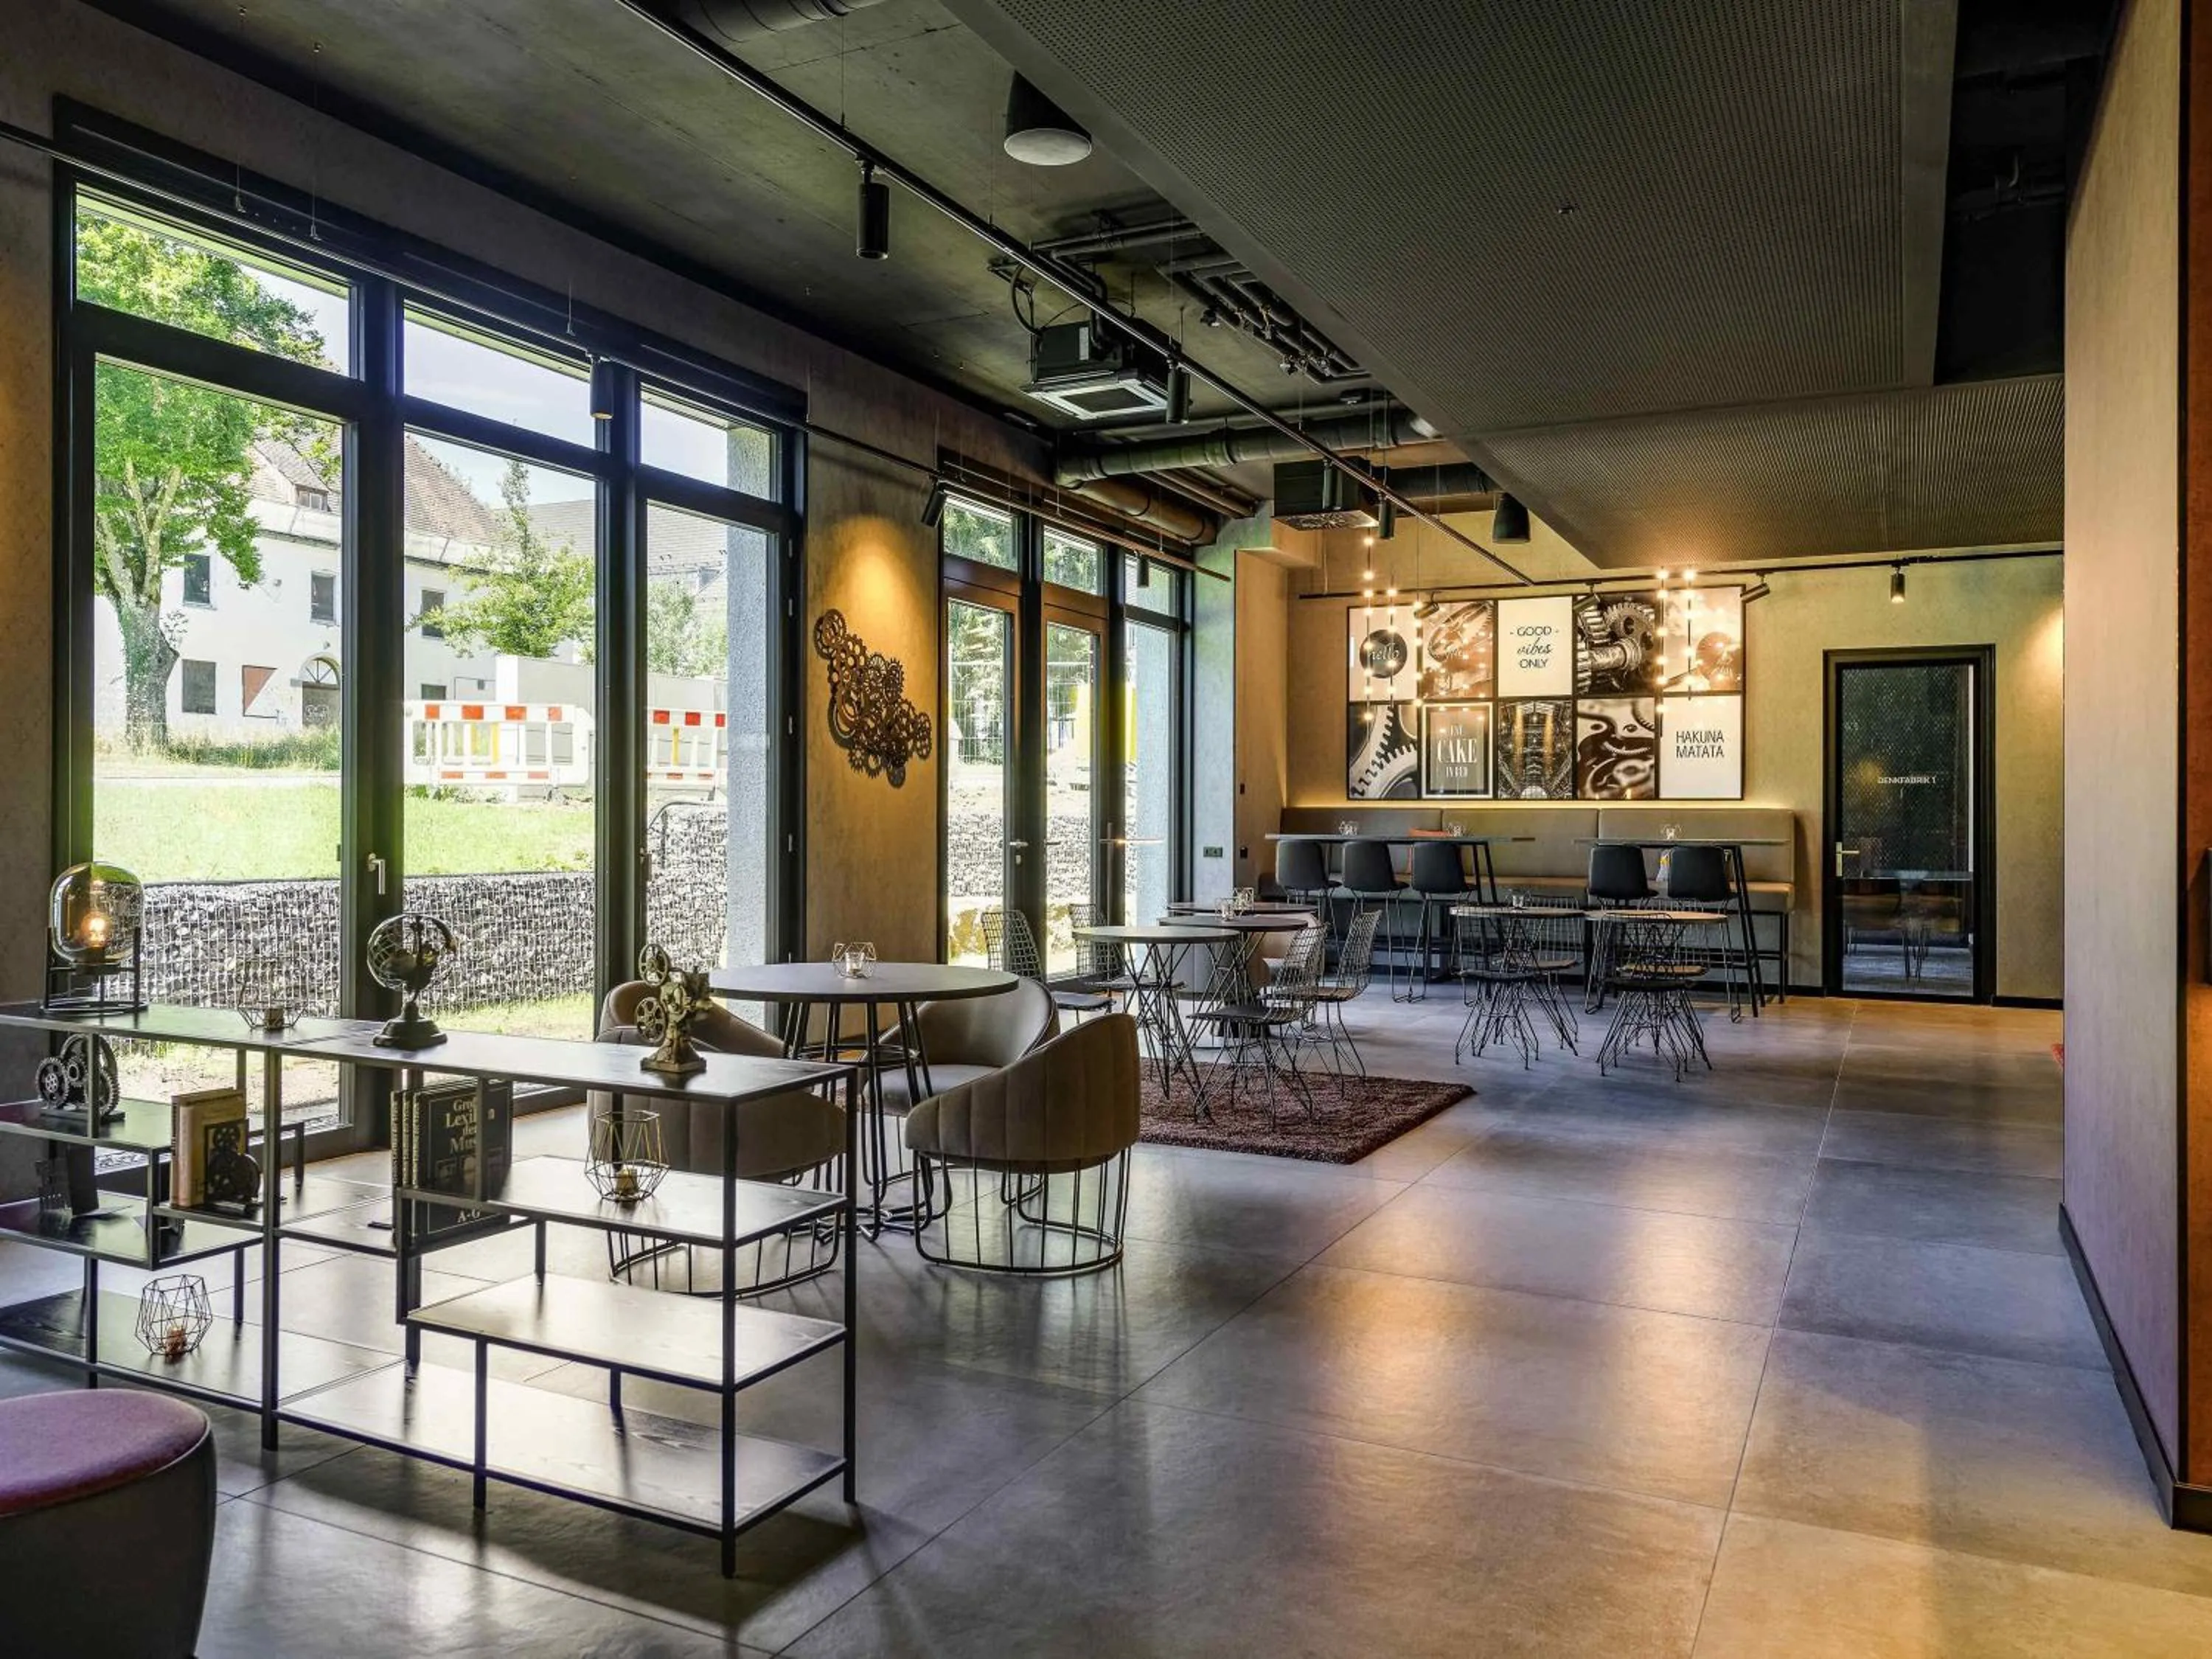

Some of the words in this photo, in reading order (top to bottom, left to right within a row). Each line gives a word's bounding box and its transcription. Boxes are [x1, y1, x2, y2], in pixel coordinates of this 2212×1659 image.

[1517, 625, 1552, 636] GOOD
[1517, 636, 1552, 655] vibes
[1520, 658, 1548, 669] ONLY
[1676, 730, 1725, 743] HAKUNA
[1437, 738, 1478, 763] CAKE
[1676, 745, 1725, 758] MATATA
